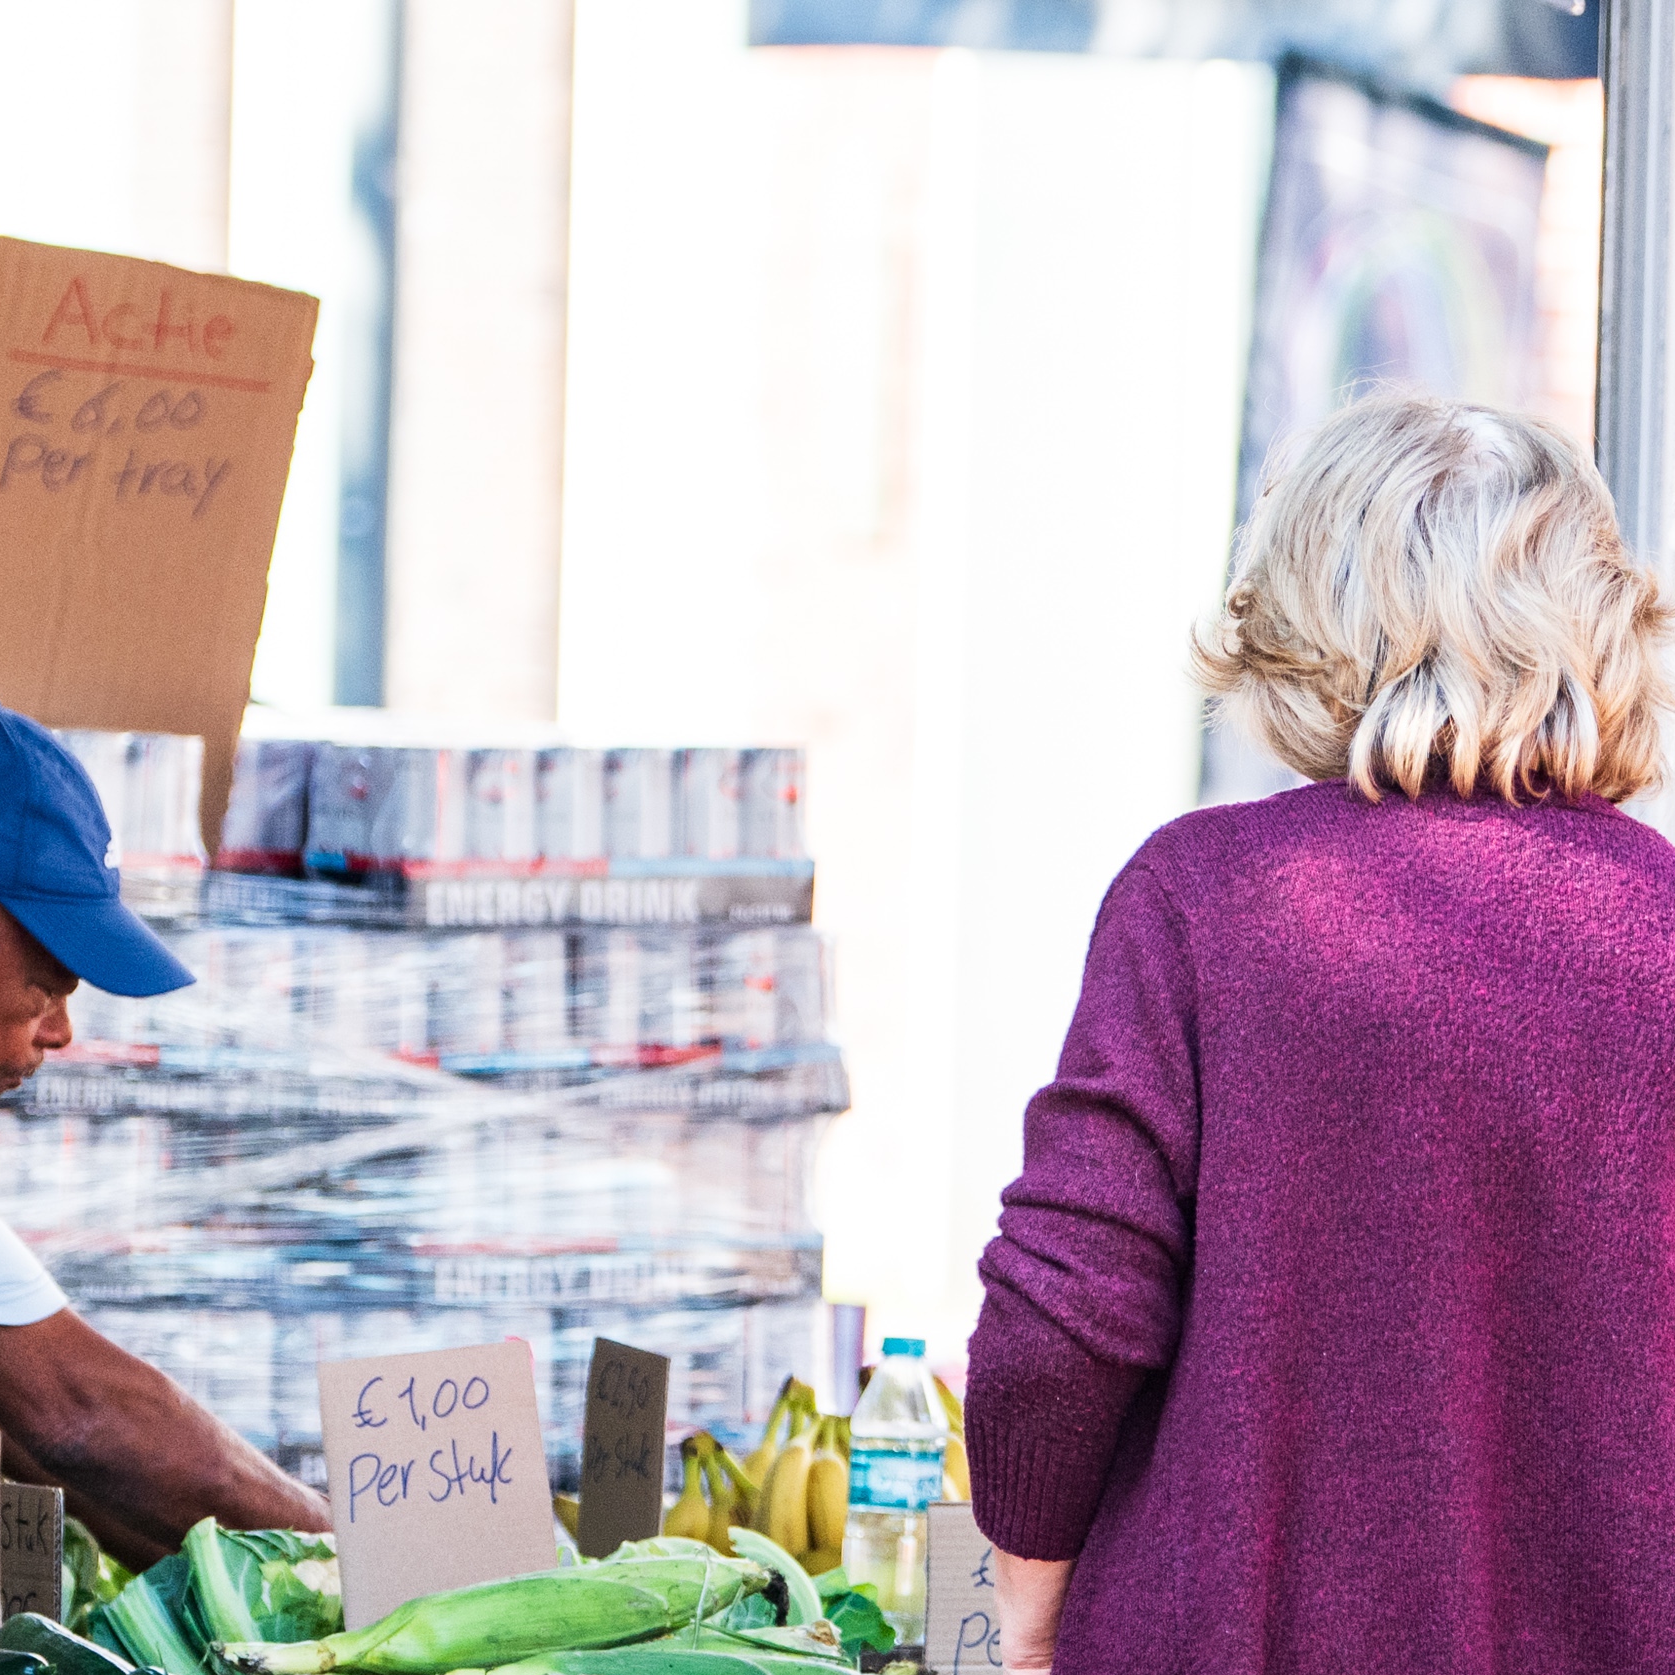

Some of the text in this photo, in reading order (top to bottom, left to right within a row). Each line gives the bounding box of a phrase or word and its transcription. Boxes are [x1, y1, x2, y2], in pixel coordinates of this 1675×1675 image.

[113, 449, 231, 520] tray
[426, 879, 572, 925] ENERGY
[579, 879, 700, 922] DRINK
[353, 1376, 489, 1428] €1,00
